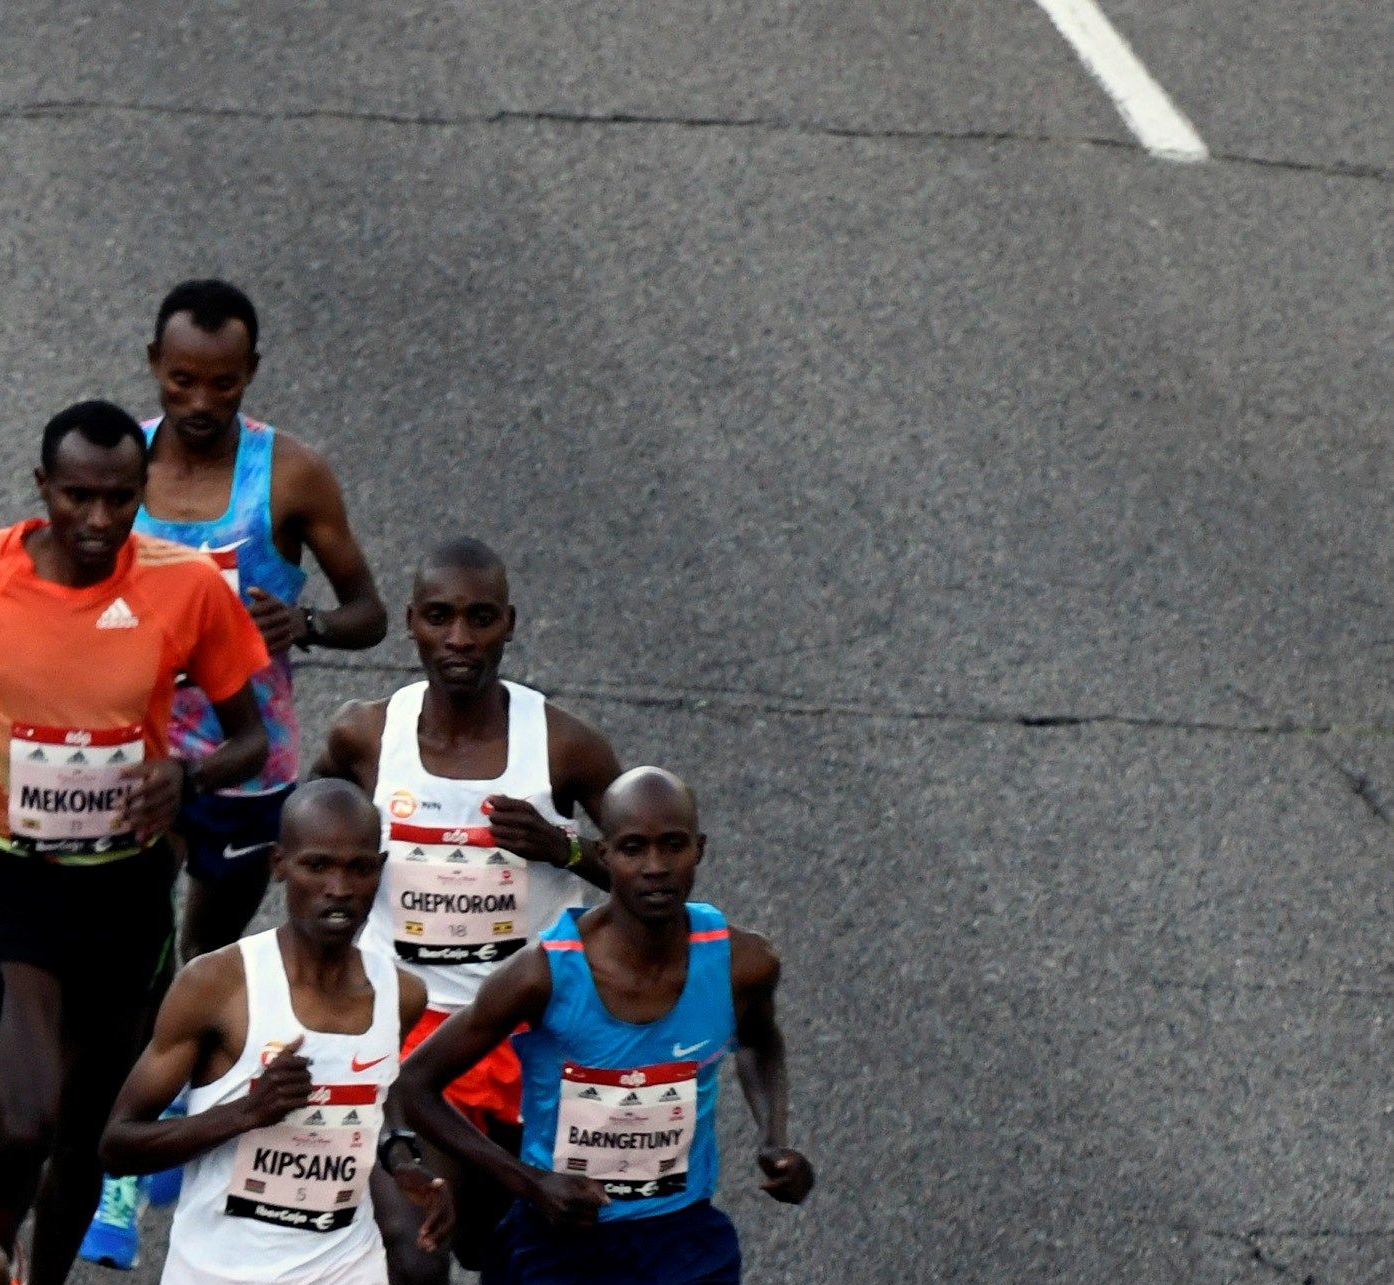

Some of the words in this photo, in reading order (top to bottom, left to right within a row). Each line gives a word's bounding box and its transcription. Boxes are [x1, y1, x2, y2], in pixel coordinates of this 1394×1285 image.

[401, 890, 517, 914] CHEPKOROM
[568, 1125, 683, 1150] BARNGETUNY
[253, 1148, 357, 1182] KIPSANG
[618, 1159, 630, 1174] 2
